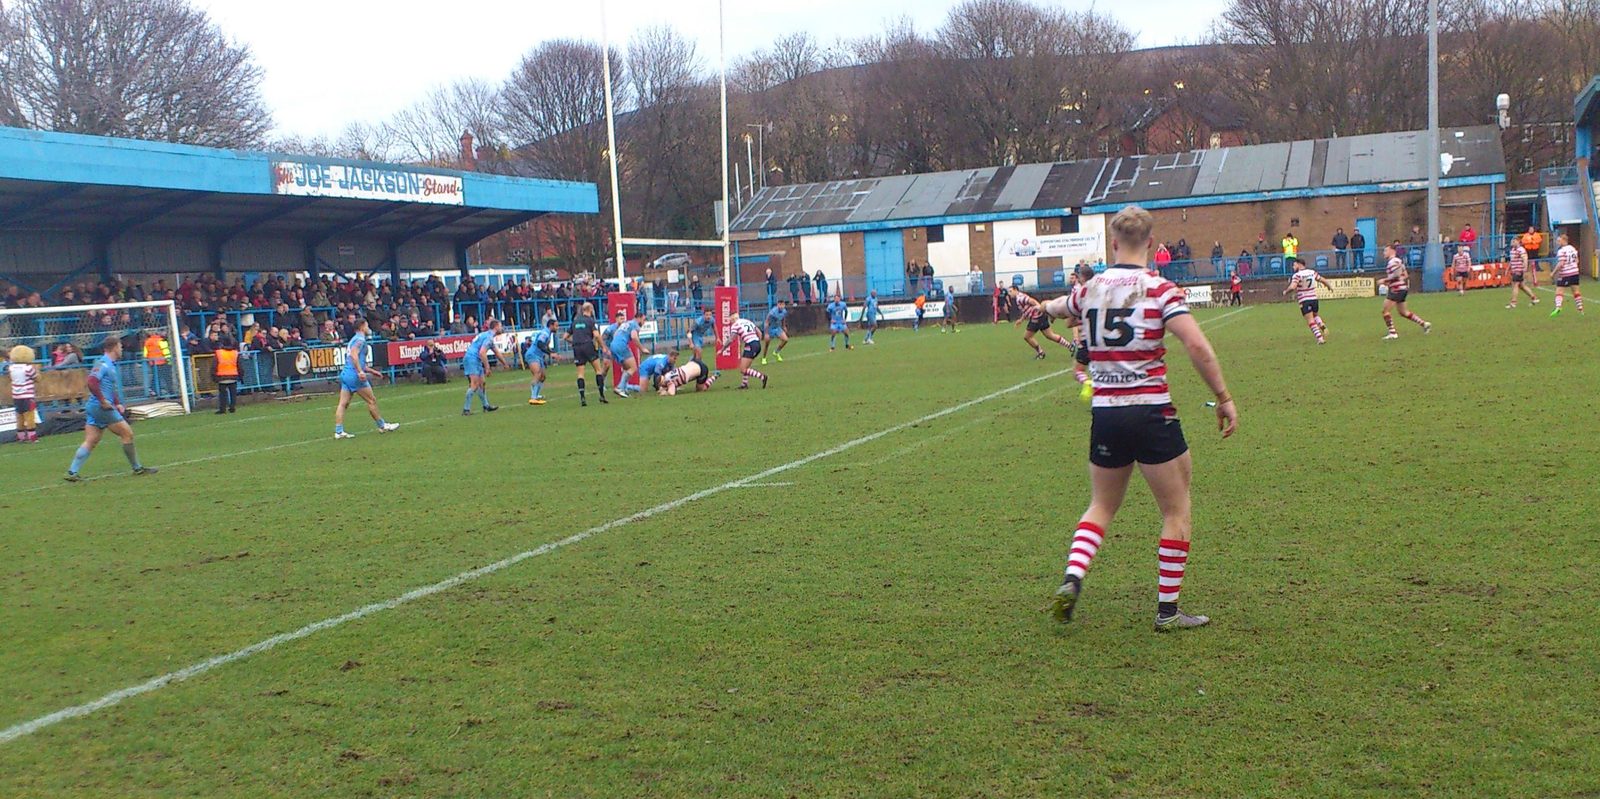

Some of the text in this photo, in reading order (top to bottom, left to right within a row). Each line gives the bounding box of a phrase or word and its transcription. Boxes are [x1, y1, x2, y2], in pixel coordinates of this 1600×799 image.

[295, 163, 332, 189] JOE
[339, 166, 420, 195] JACKSON
[423, 177, 459, 197] Stand
[1305, 278, 1313, 289] 7
[1086, 308, 1136, 347] 15
[309, 345, 373, 369] vanara
[399, 344, 425, 360] Kingst
